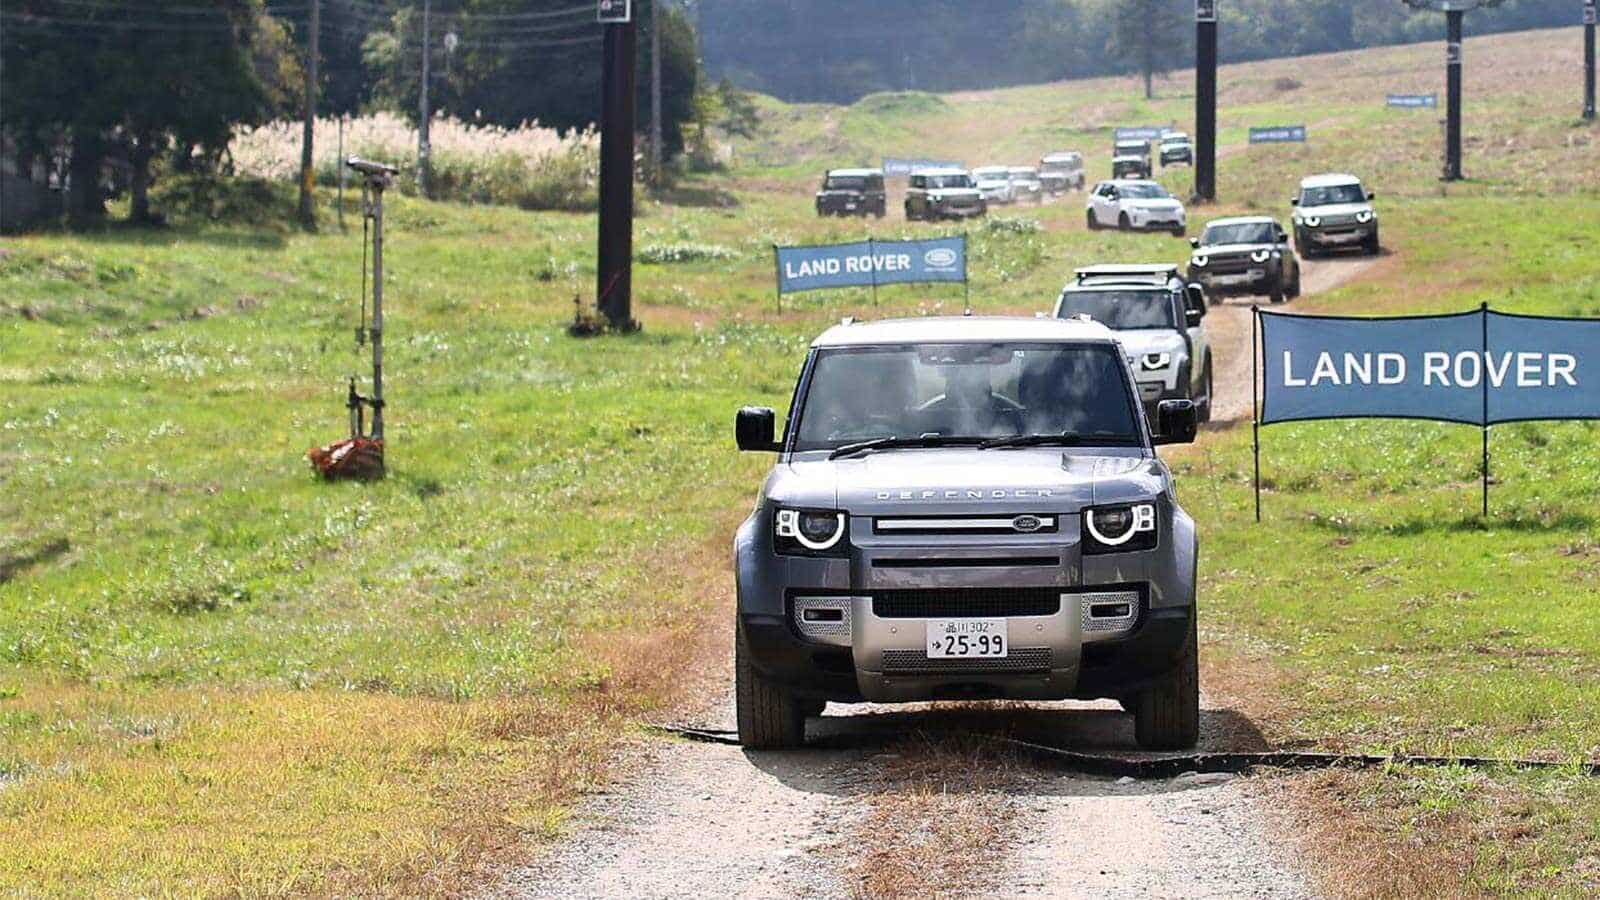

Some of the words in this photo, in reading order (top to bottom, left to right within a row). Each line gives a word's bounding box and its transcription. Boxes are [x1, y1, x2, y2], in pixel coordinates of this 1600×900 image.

[785, 257, 840, 279] LAND
[845, 254, 911, 273] ROVER
[1283, 350, 1406, 387] LAND
[1423, 350, 1578, 388] ROVER
[876, 489, 1054, 501] DEFENDER
[970, 622, 989, 633] 302
[945, 635, 1003, 656] 25-99
